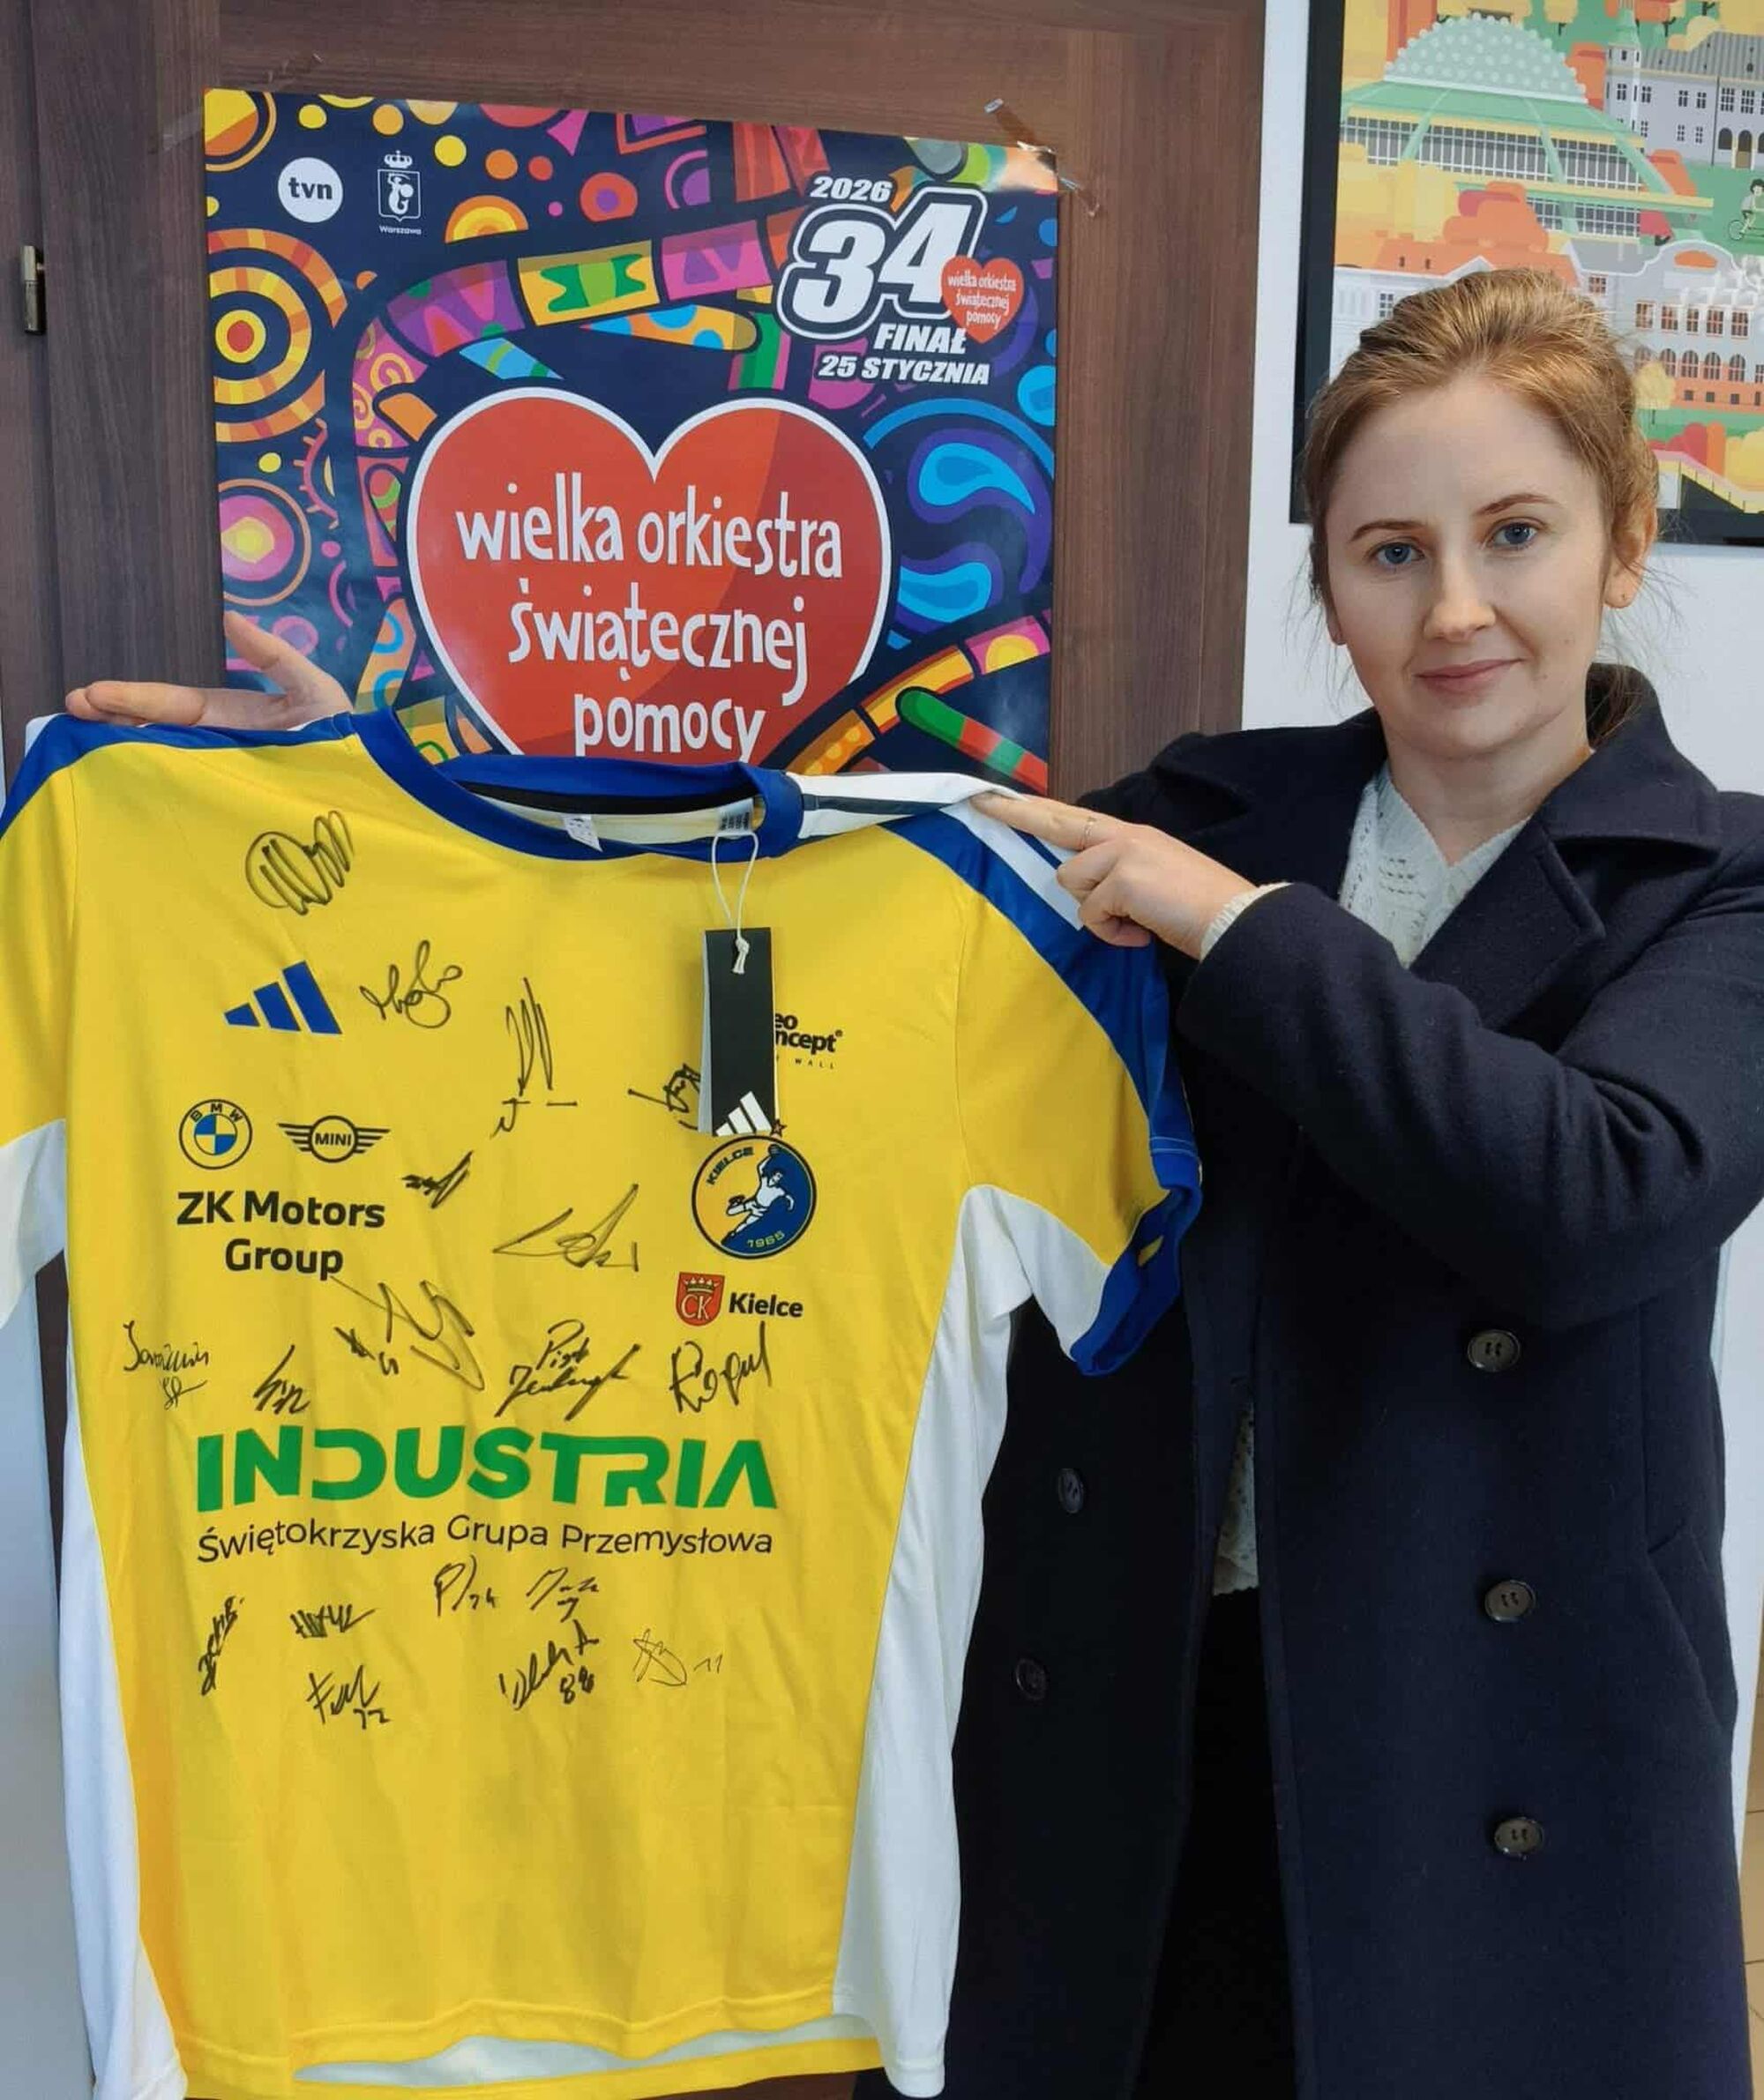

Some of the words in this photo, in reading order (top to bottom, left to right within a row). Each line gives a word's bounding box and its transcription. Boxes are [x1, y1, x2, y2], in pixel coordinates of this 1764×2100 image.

[288, 177, 333, 200] tvn
[810, 176, 893, 203] 2026
[378, 225, 422, 235] Warszawa
[791, 200, 973, 324] 34
[873, 323, 968, 355] FINAŁ
[818, 355, 856, 377] 25
[862, 357, 990, 385] STYCZNIA
[455, 472, 624, 563] wielka
[637, 484, 843, 579] orkiestra
[508, 578, 809, 706] świątecznej
[574, 693, 766, 764] pomocy
[774, 1013, 798, 1030] eo
[189, 1102, 244, 1123] BMW
[314, 1132, 352, 1147] MINI
[706, 1146, 754, 1185] KIELCE
[176, 1191, 235, 1225] ZK
[243, 1191, 385, 1229] Motors
[747, 1230, 786, 1248] 1965
[225, 1237, 343, 1281] Group
[729, 1291, 804, 1318] Kielce
[197, 1424, 778, 1513] INDUSTRIA
[197, 1518, 436, 1562] Świętokrzyska
[446, 1513, 549, 1552] Grupa
[561, 1523, 774, 1555] Przemysłowa
